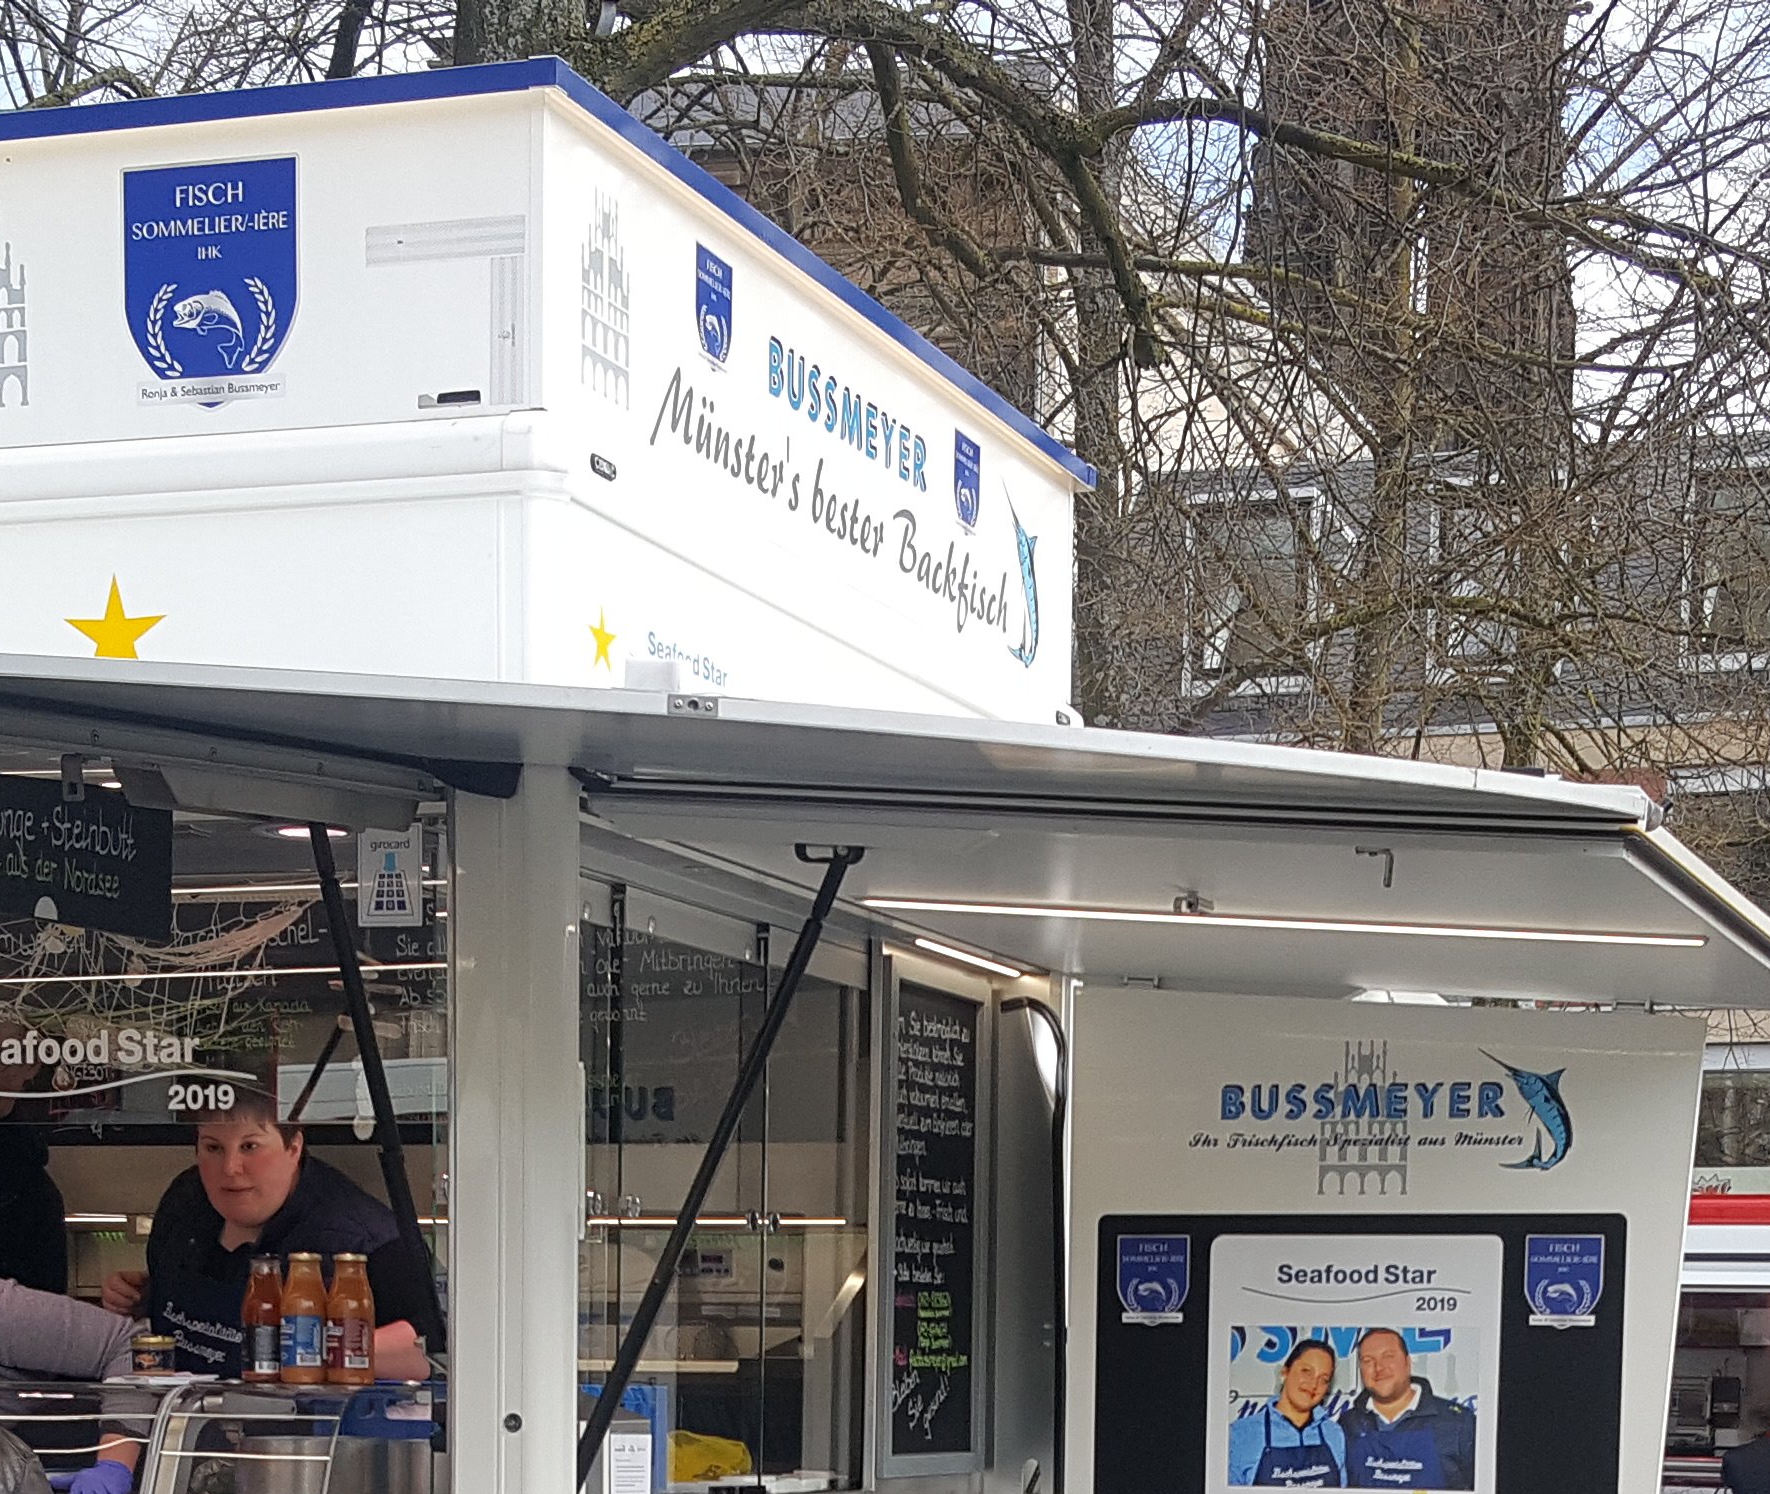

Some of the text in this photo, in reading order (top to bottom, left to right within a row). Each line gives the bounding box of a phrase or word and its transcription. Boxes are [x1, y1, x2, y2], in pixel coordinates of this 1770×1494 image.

[174, 181, 244, 208] FISCH
[131, 209, 289, 241] SOMMELIER/-IÈRE
[197, 245, 223, 260] IHK
[141, 382, 281, 401] Ronja & Sebastian Bussmeyer
[767, 335, 928, 493] BUSSMEYER
[649, 366, 1009, 634] Münster's bester Backfisch
[702, 656, 728, 688] Star
[369, 838, 411, 852] girocard
[5, 850, 29, 879] aus
[34, 851, 58, 883] der
[63, 856, 121, 898] Nordsee
[117, 1028, 202, 1065] Star
[167, 1083, 235, 1111] 2019
[1219, 1080, 1506, 1121] BUSSMEYER
[1188, 1131, 1525, 1152] Ihr Frischfisch Spezialist aus Münster
[1277, 1263, 1437, 1285] Seafood Star
[1414, 1296, 1458, 1312] 2019
